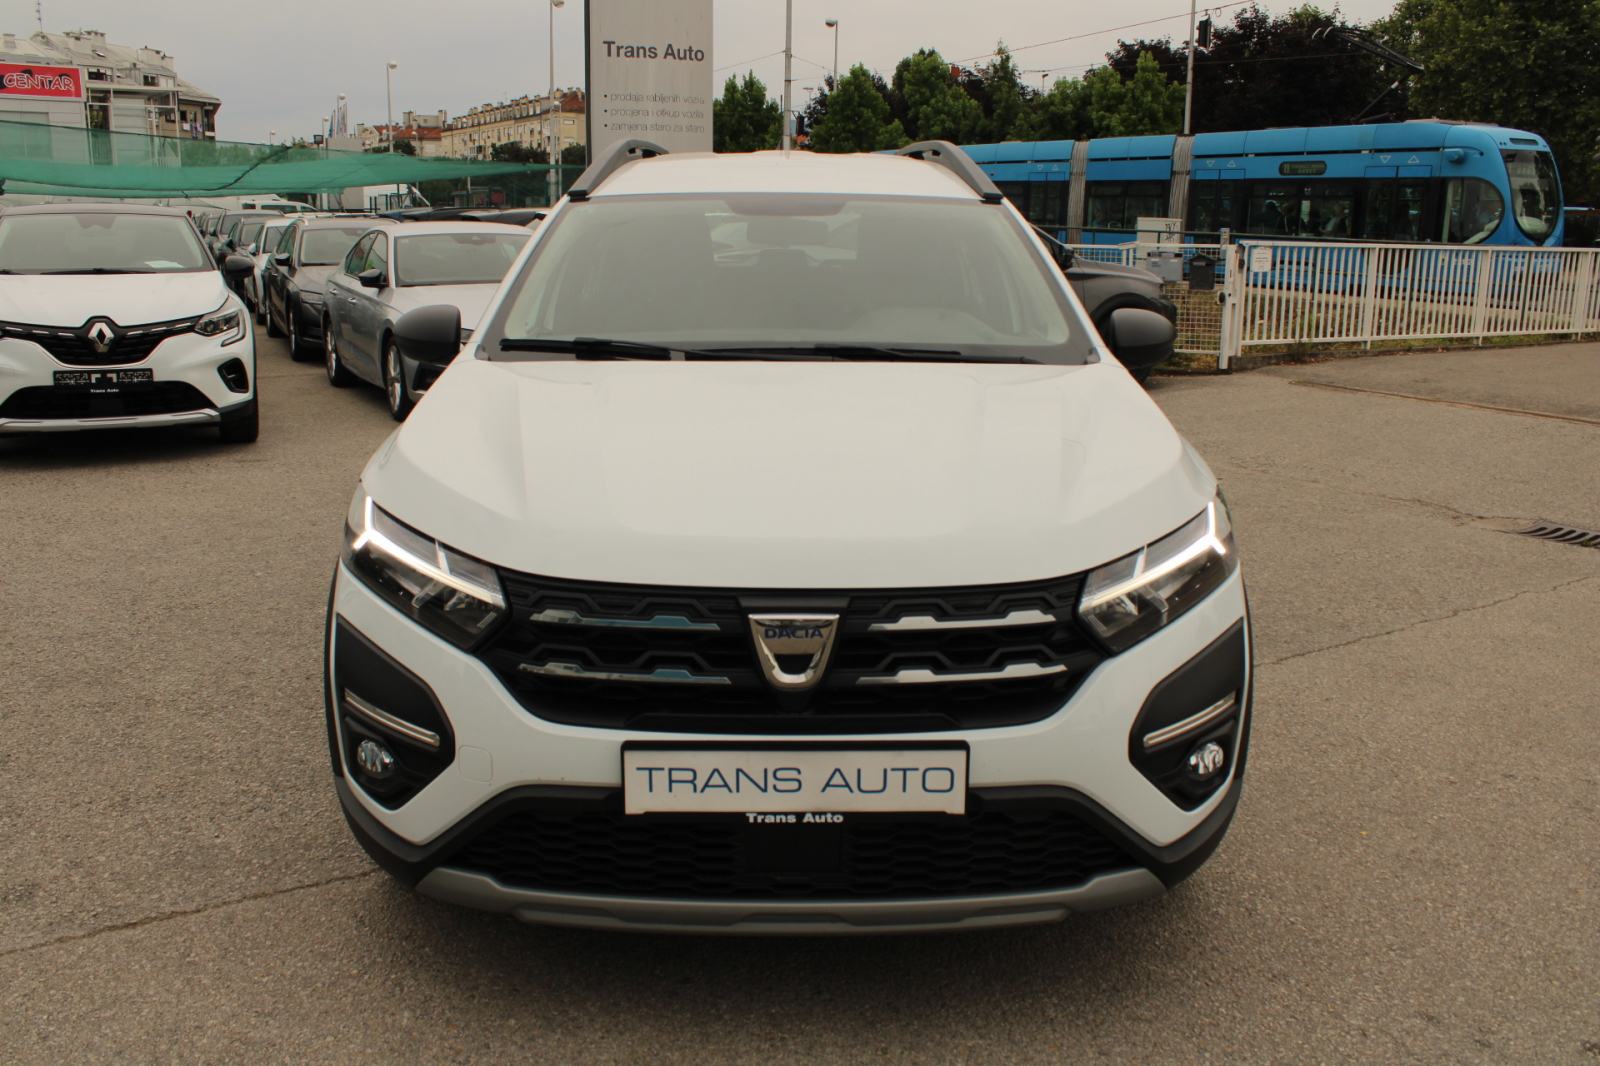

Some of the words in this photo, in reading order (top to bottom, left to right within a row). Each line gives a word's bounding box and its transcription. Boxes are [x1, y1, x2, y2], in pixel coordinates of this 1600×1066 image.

[602, 40, 658, 59] Trans
[663, 43, 705, 62] Auto
[3, 73, 75, 91] CENTAR
[764, 627, 824, 639] DACIA
[636, 767, 802, 793] TRANS
[821, 767, 955, 793] AUTO
[745, 812, 797, 823] Trans
[802, 812, 844, 823] Auto
